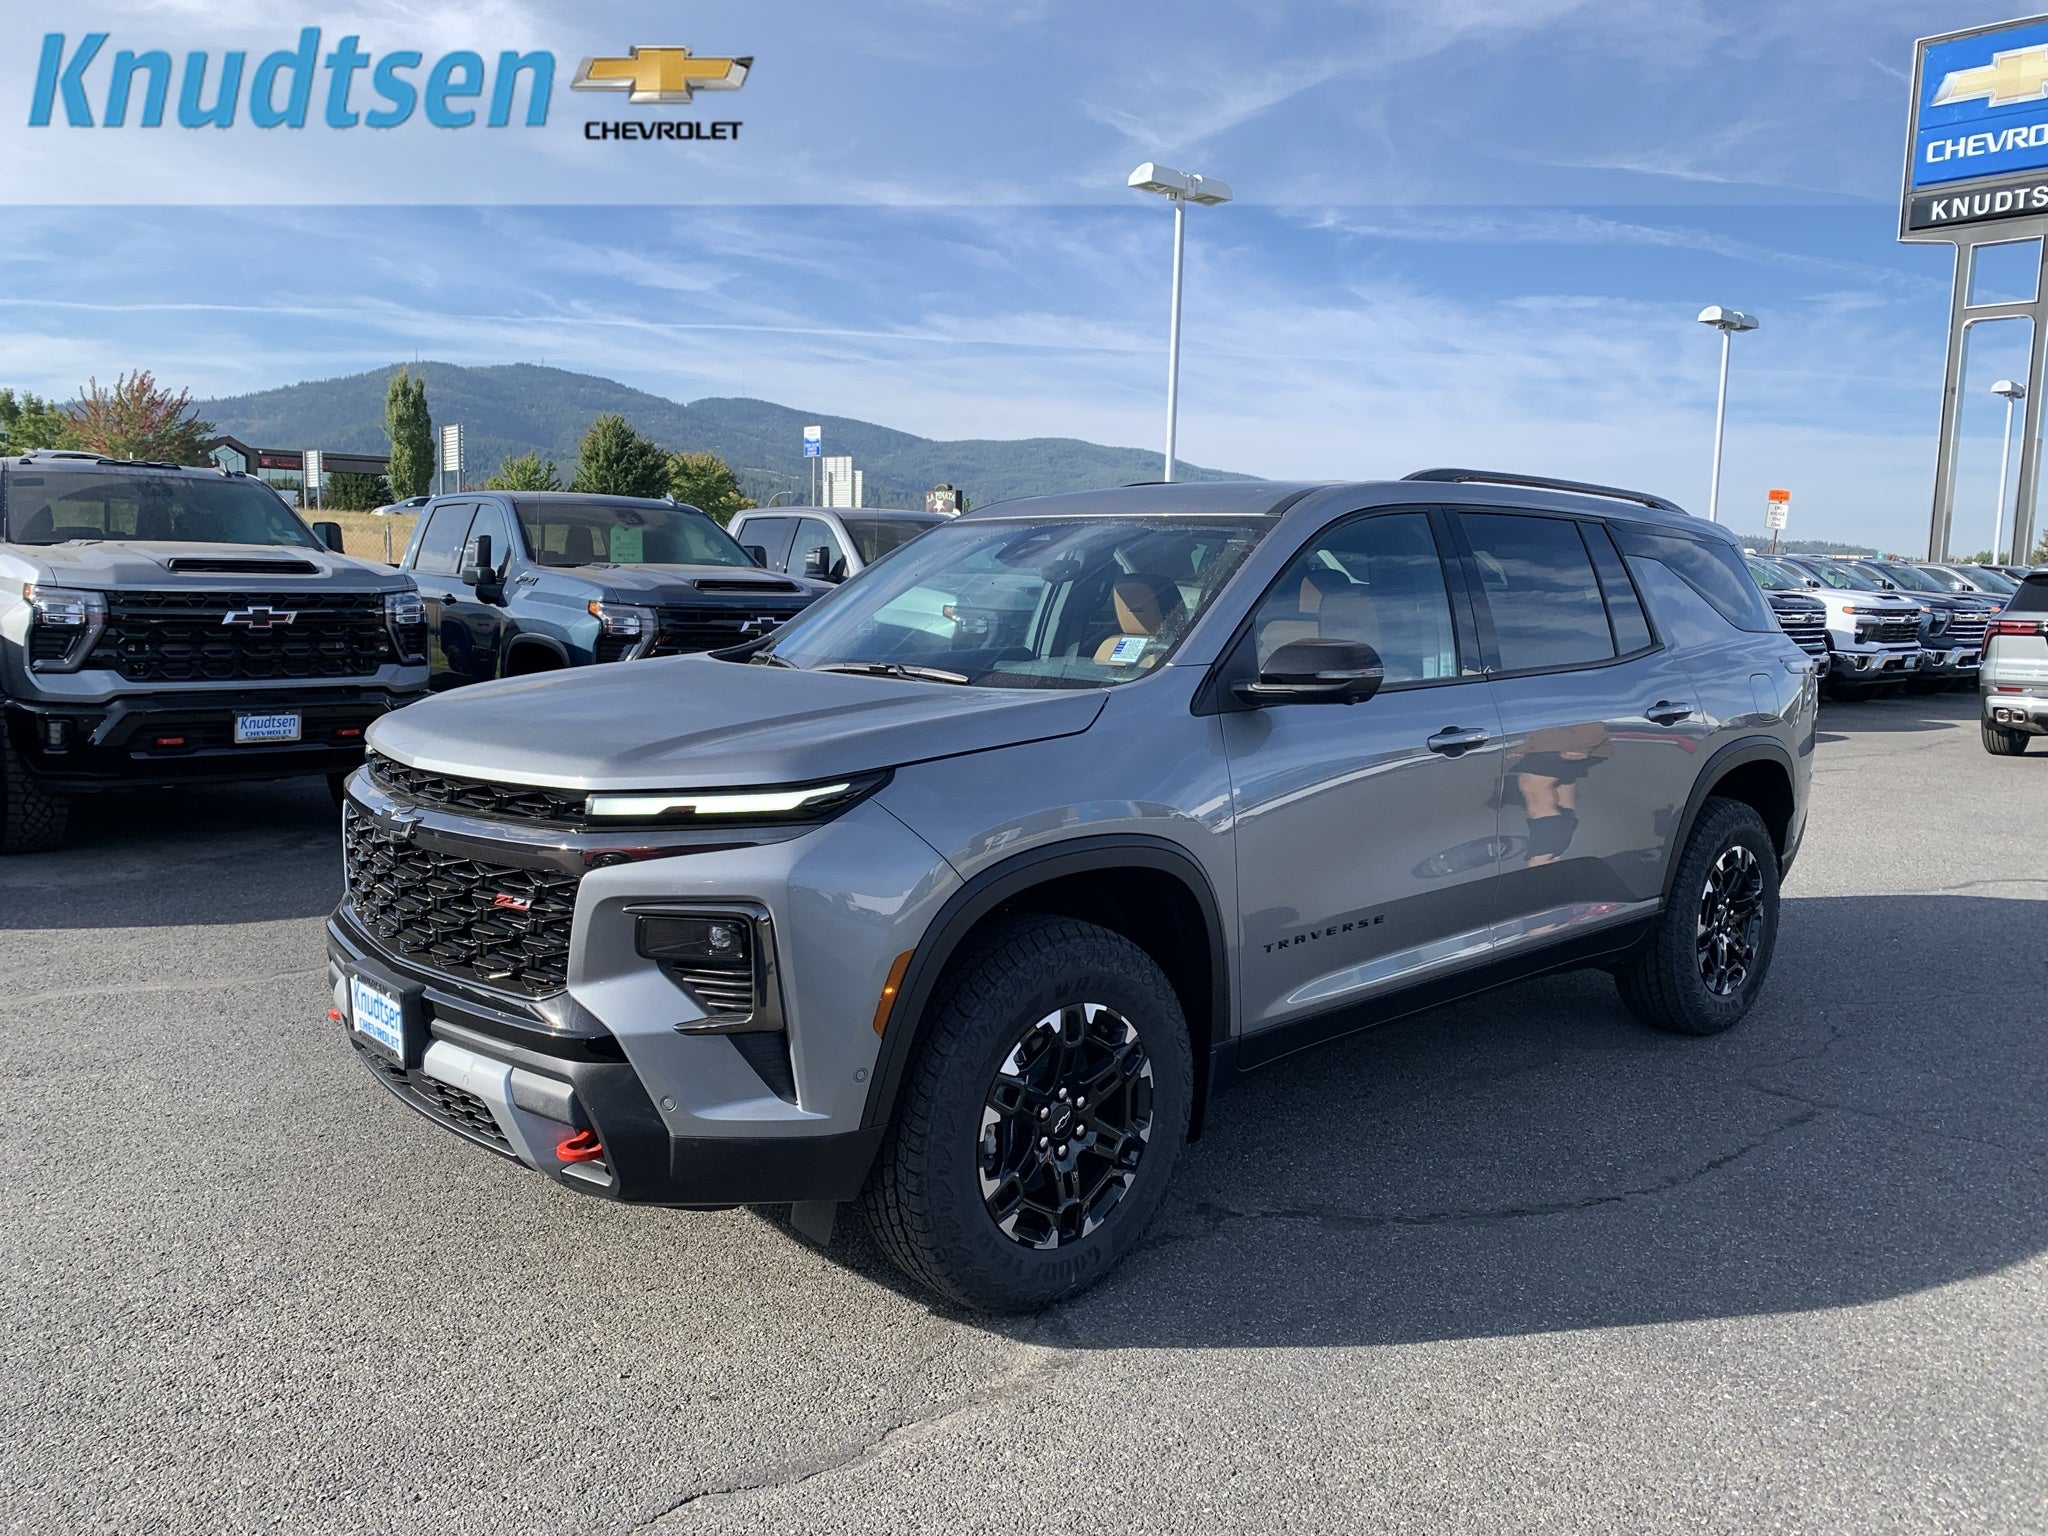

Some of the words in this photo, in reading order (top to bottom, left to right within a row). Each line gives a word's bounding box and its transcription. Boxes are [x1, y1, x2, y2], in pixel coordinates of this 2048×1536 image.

[926, 493, 934, 503] LA
[240, 716, 296, 730] Knudtsen
[246, 729, 292, 737] CHEVROLET
[1263, 914, 1385, 954] TRAVERSE
[360, 1016, 400, 1050] CHEVROLET
